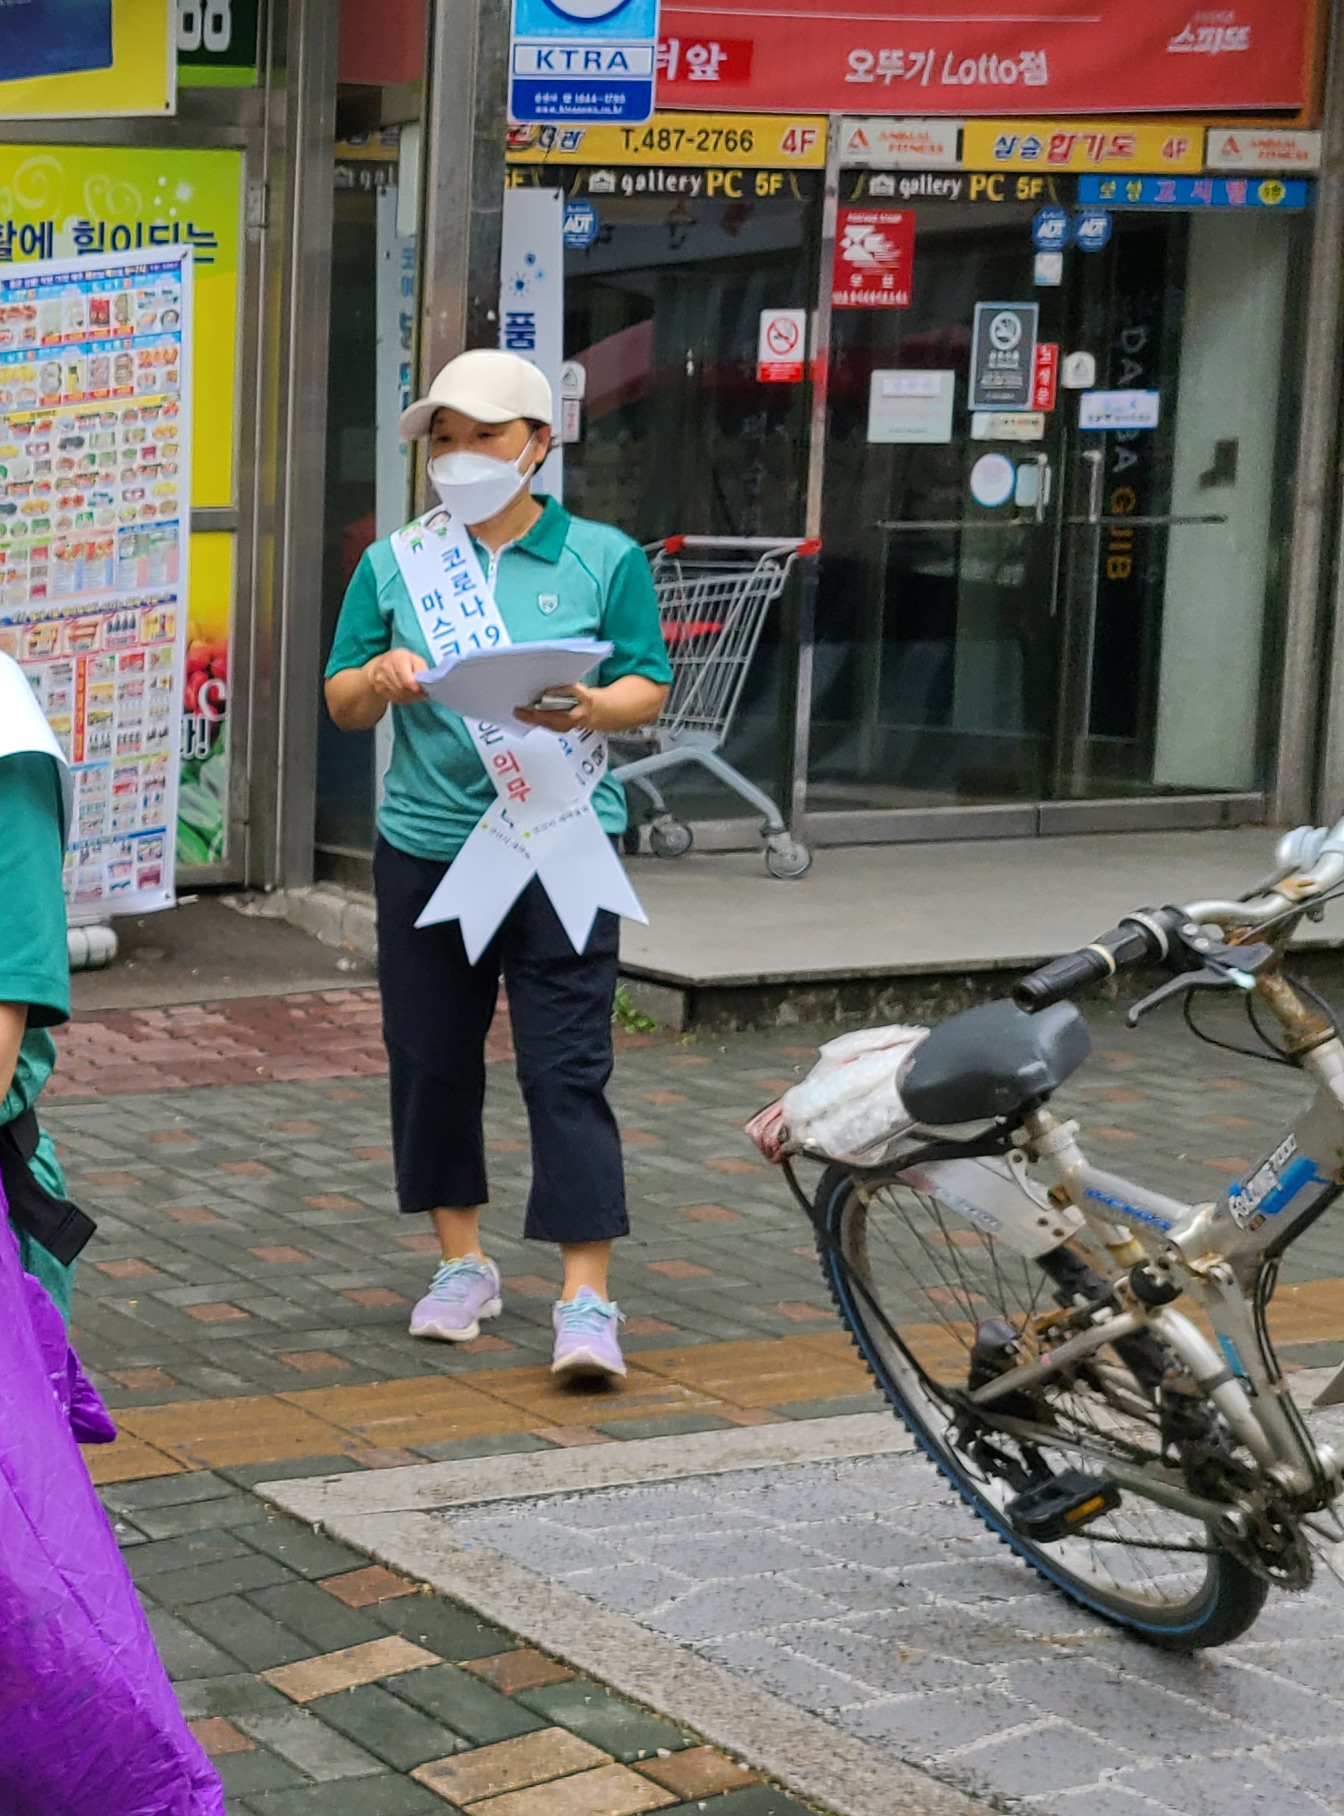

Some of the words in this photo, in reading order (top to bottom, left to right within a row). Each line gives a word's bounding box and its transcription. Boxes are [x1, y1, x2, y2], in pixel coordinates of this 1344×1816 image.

[536, 49, 629, 70] KTRA
[844, 47, 934, 87] 오뚜기
[940, 48, 1049, 87] Lotto점
[621, 128, 754, 153] T.487-2766
[781, 129, 816, 153] 4F
[1162, 136, 1190, 161] 4F
[621, 168, 703, 198] gallery
[706, 169, 743, 198] PC
[755, 170, 784, 196] 5F
[899, 173, 962, 199] gallery
[969, 174, 1005, 201] PC
[1016, 176, 1045, 200] 5F
[563, 214, 594, 234] ADT
[1037, 219, 1066, 238] ADT
[1078, 218, 1107, 237] ADT
